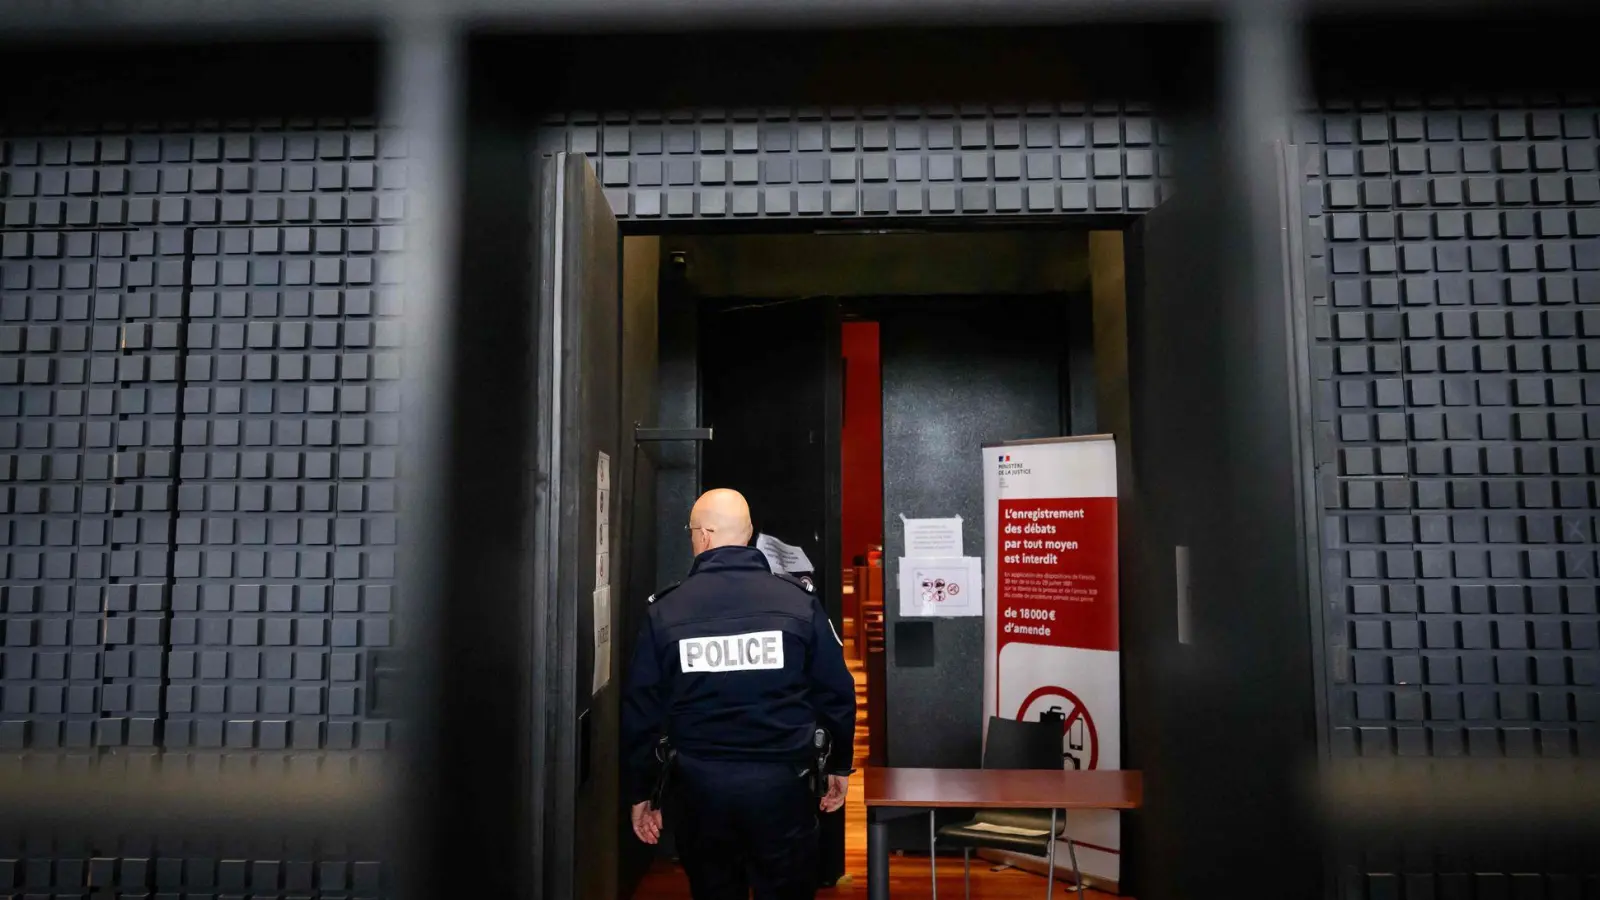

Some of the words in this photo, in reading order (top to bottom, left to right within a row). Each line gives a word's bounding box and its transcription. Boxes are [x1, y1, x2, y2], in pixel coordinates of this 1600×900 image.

[1005, 523, 1022, 534] des
[1024, 523, 1056, 534] débats
[1005, 540, 1021, 551] par
[1023, 539, 1042, 549] tout
[1045, 540, 1078, 552] moyen
[1004, 555, 1020, 563] est
[1022, 553, 1058, 564] interdit
[1004, 607, 1018, 618] de
[686, 637, 777, 667] POLICE
